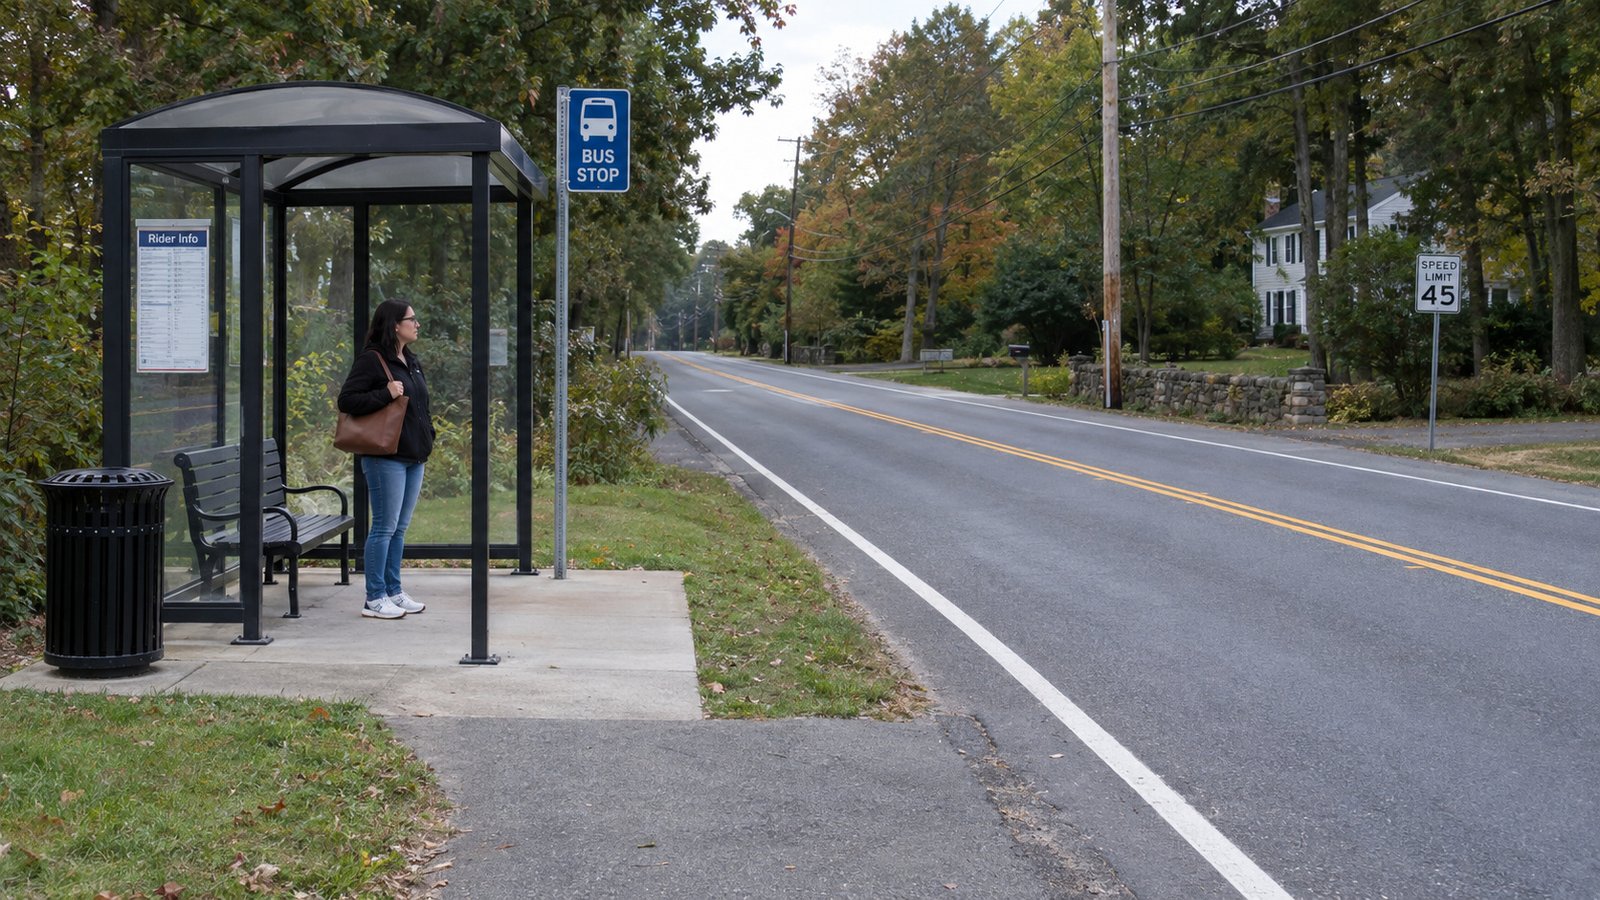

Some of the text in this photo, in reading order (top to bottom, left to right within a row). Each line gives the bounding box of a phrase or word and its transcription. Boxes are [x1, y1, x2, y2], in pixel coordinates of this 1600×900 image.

[582, 149, 615, 164] BUS
[577, 167, 620, 182] STOP
[148, 233, 199, 244] Rider Info
[1421, 260, 1457, 270] SPEED
[1425, 273, 1452, 281] LIMIT
[1421, 284, 1455, 306] 45
